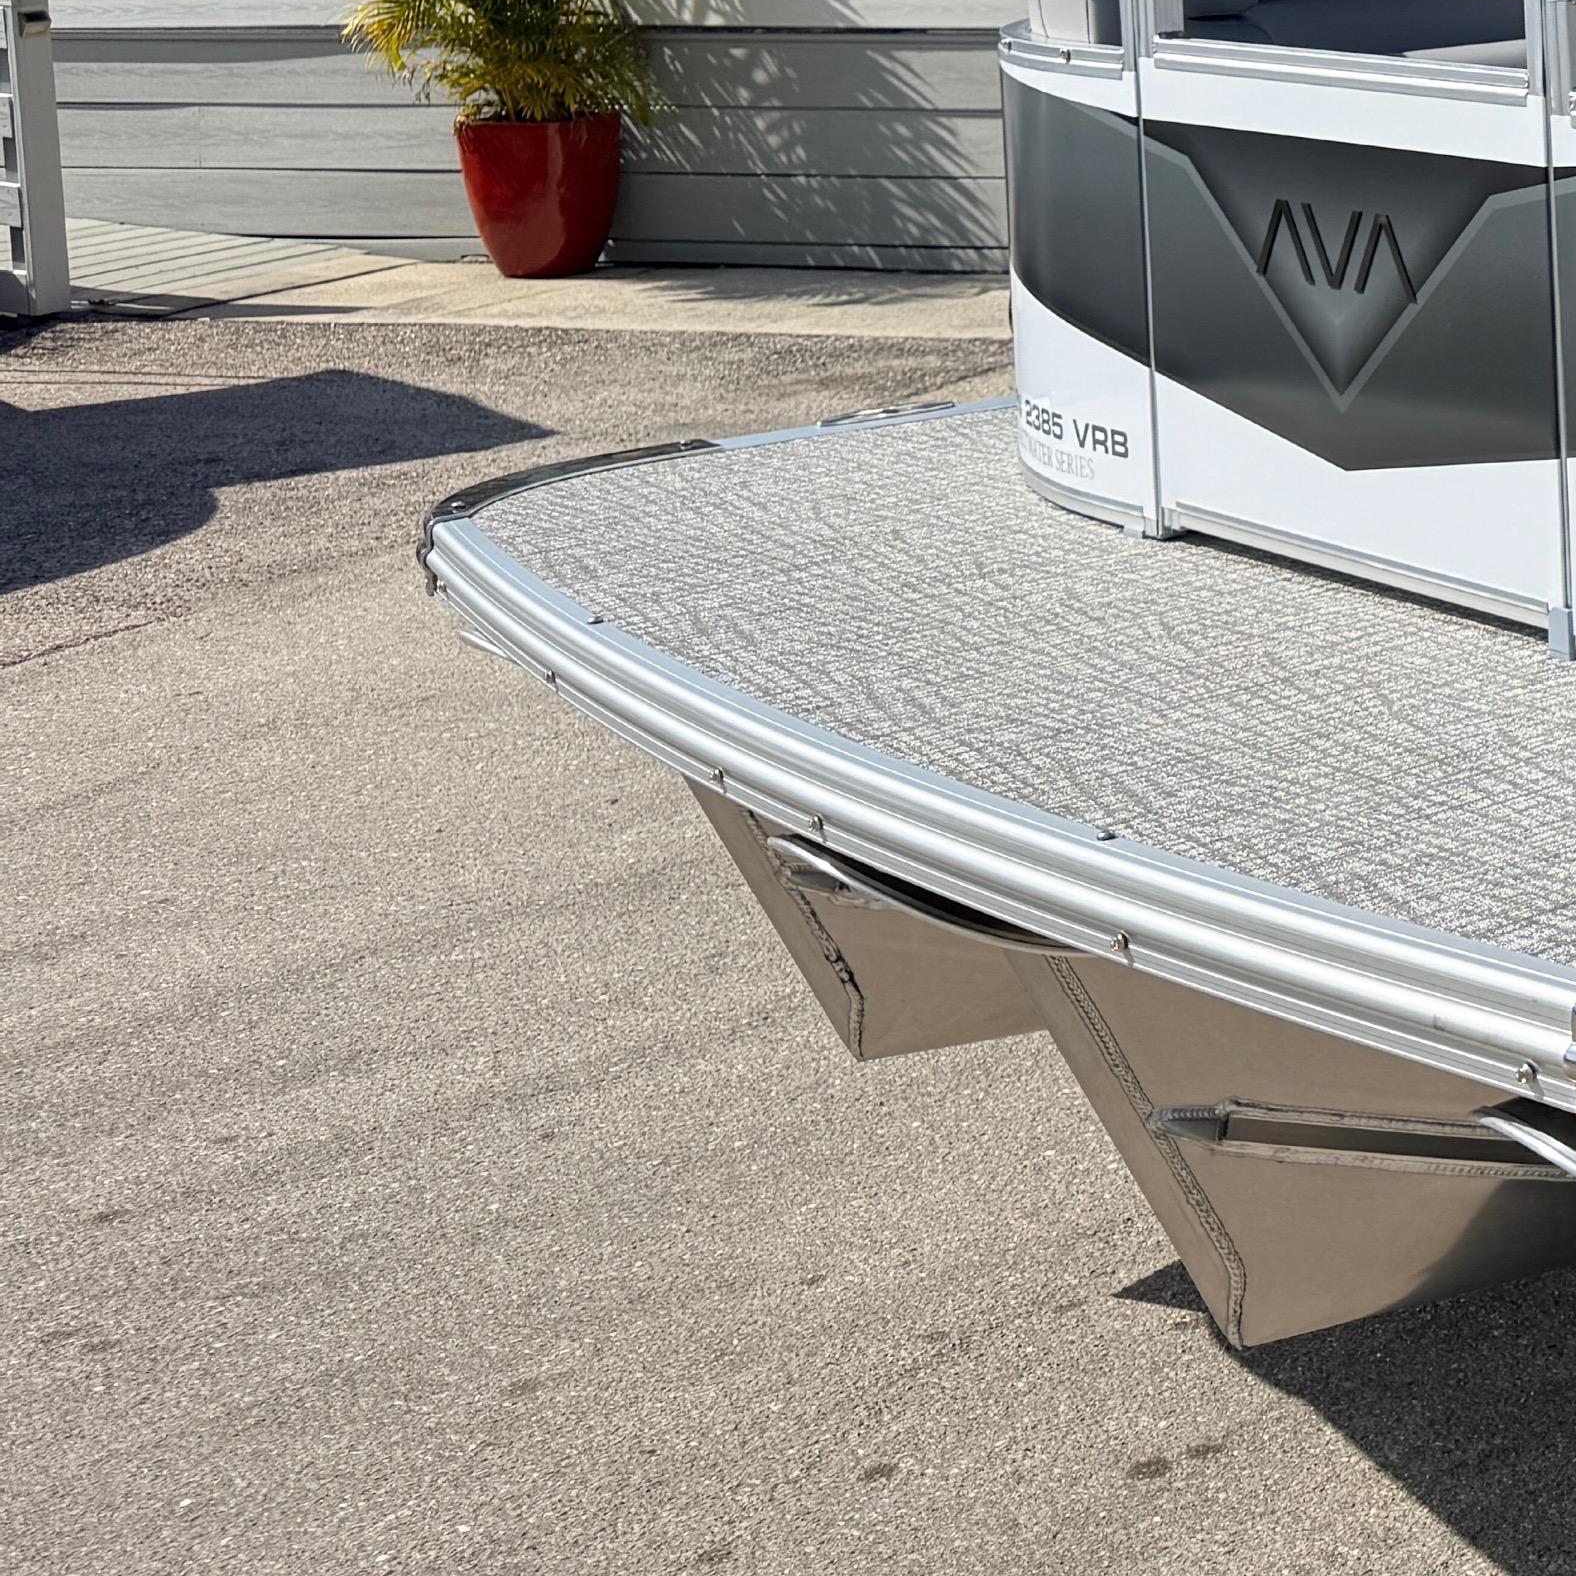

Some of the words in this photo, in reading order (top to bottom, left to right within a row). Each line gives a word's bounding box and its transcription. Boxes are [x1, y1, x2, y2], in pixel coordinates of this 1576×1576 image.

[1256, 198, 1418, 304] AVA
[1025, 399, 1063, 440] 2385
[1073, 418, 1129, 458] VRB
[1055, 449, 1095, 480] SERIES
